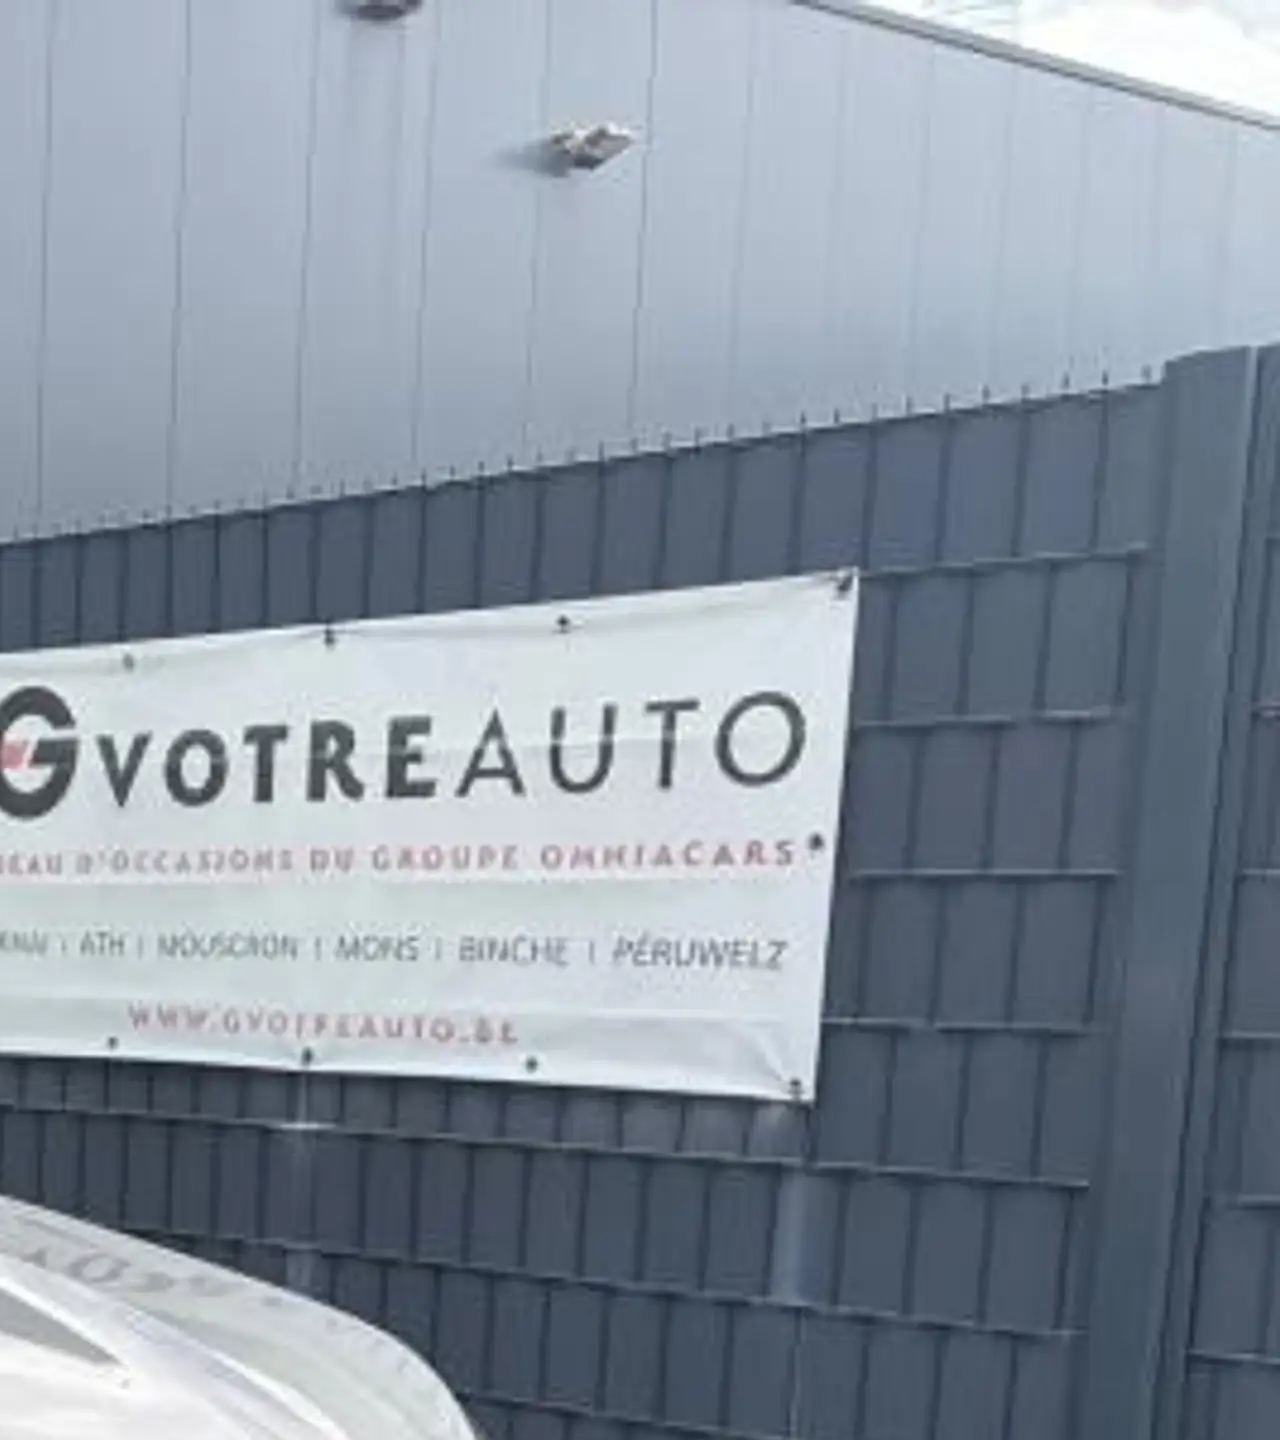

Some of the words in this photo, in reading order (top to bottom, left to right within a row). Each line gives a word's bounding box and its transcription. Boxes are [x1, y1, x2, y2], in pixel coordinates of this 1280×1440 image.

[309, 847, 355, 871] DU
[371, 843, 520, 872] GROUPE
[540, 838, 797, 872] OMNIACARS
[79, 931, 126, 958] ATH
[157, 933, 300, 961] MOUSCRON
[334, 934, 421, 963] MONS
[458, 937, 570, 967] BINCHE
